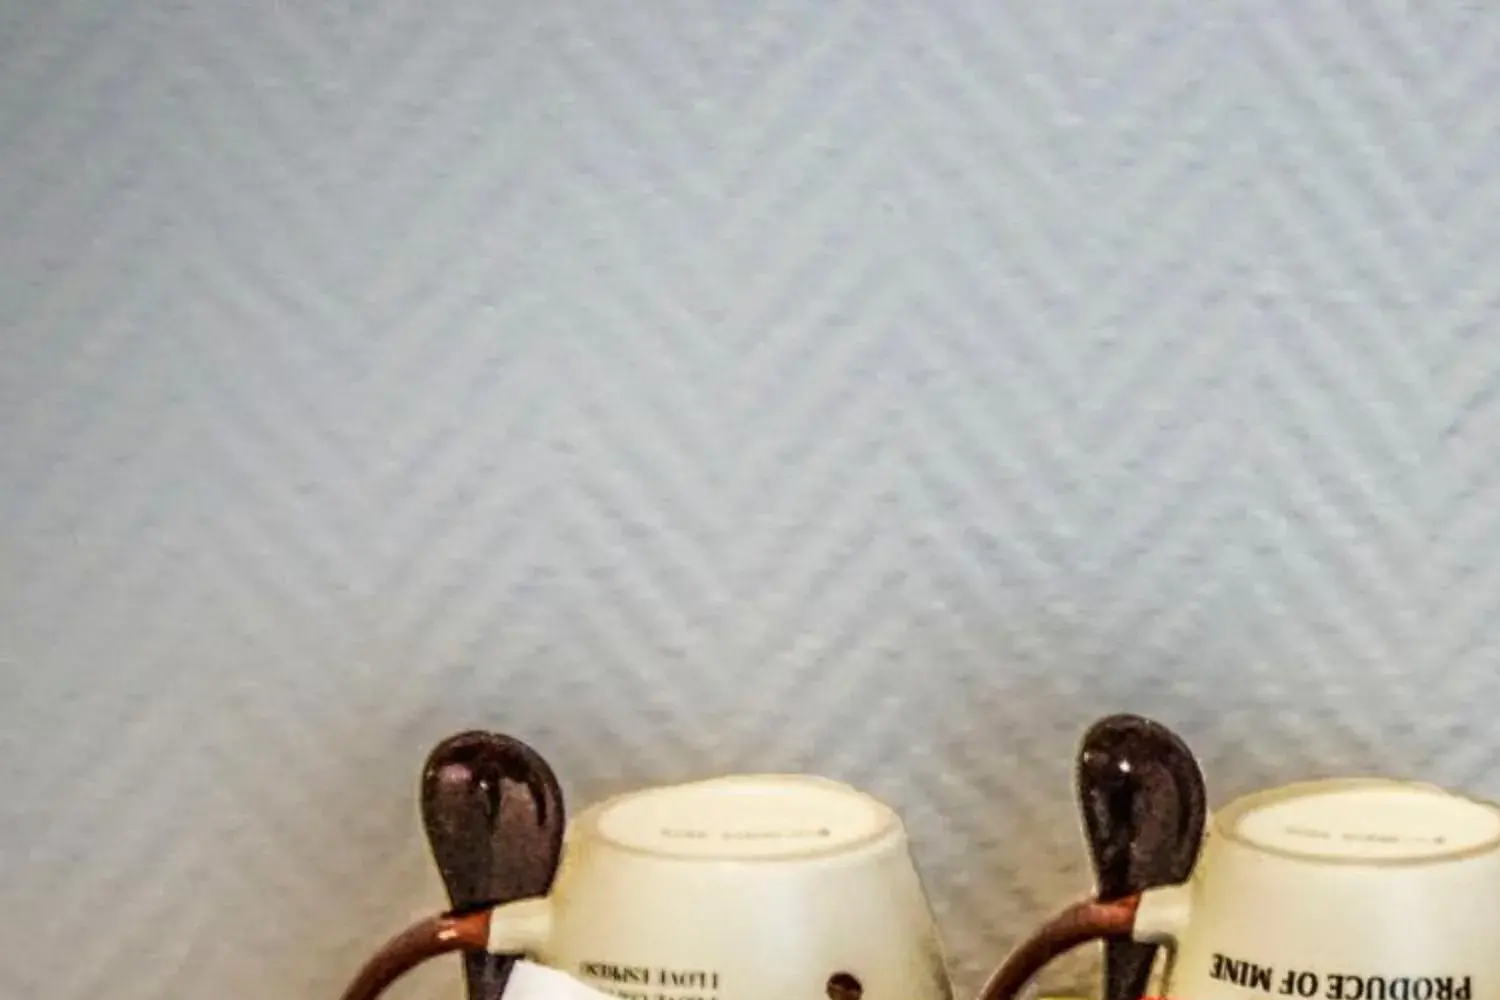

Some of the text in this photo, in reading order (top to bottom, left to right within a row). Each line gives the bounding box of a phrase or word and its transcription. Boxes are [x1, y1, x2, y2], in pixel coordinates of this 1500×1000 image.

[1209, 953, 1472, 1000] PRODUCE OF MINE
